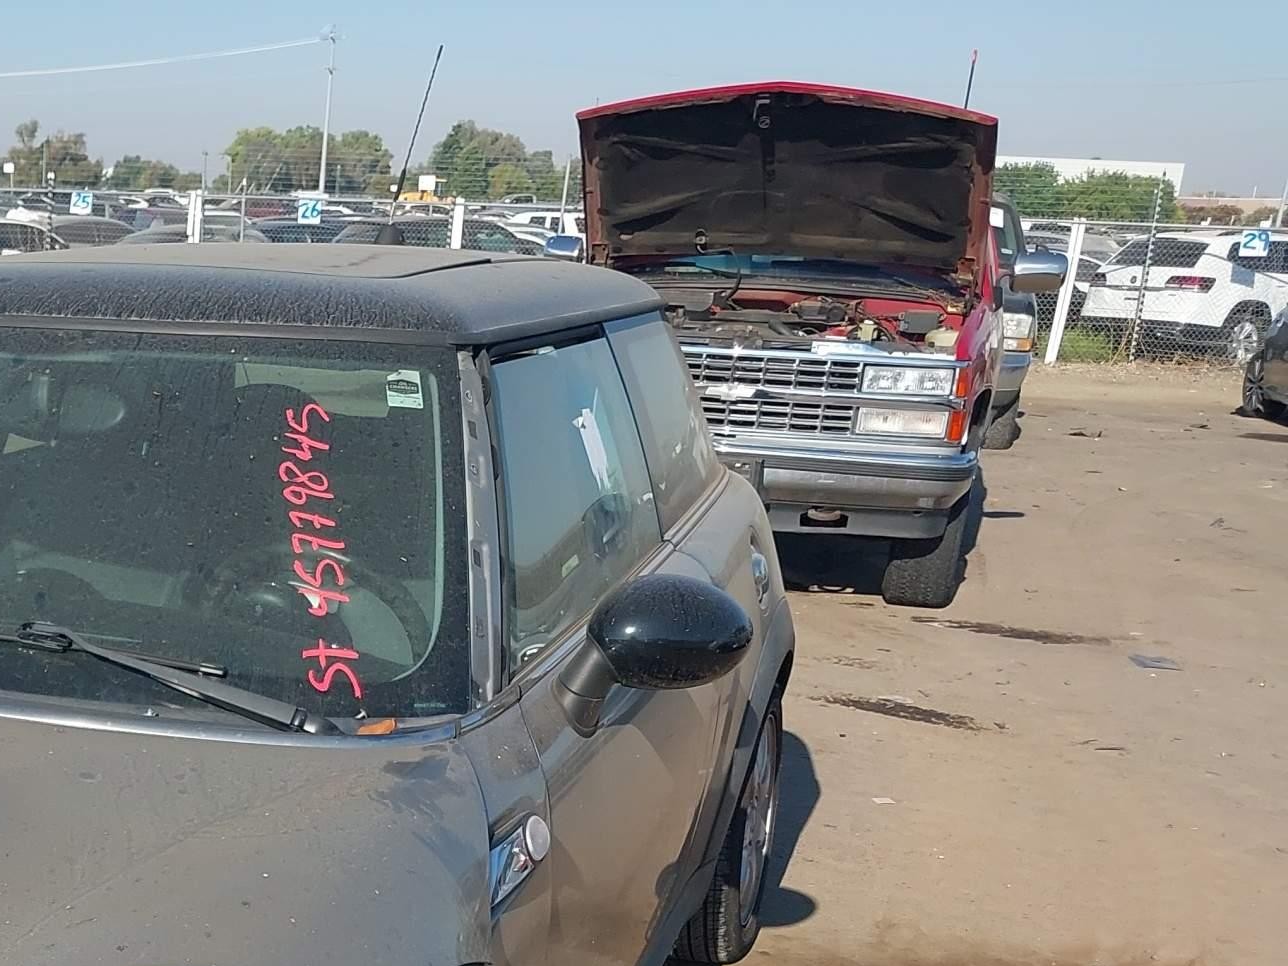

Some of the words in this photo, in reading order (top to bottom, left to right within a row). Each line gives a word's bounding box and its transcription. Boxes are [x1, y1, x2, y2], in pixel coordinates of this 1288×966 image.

[72, 192, 90, 209] 25
[298, 200, 321, 219] 26
[1242, 231, 1270, 251] 29
[278, 402, 350, 617] 45779845
